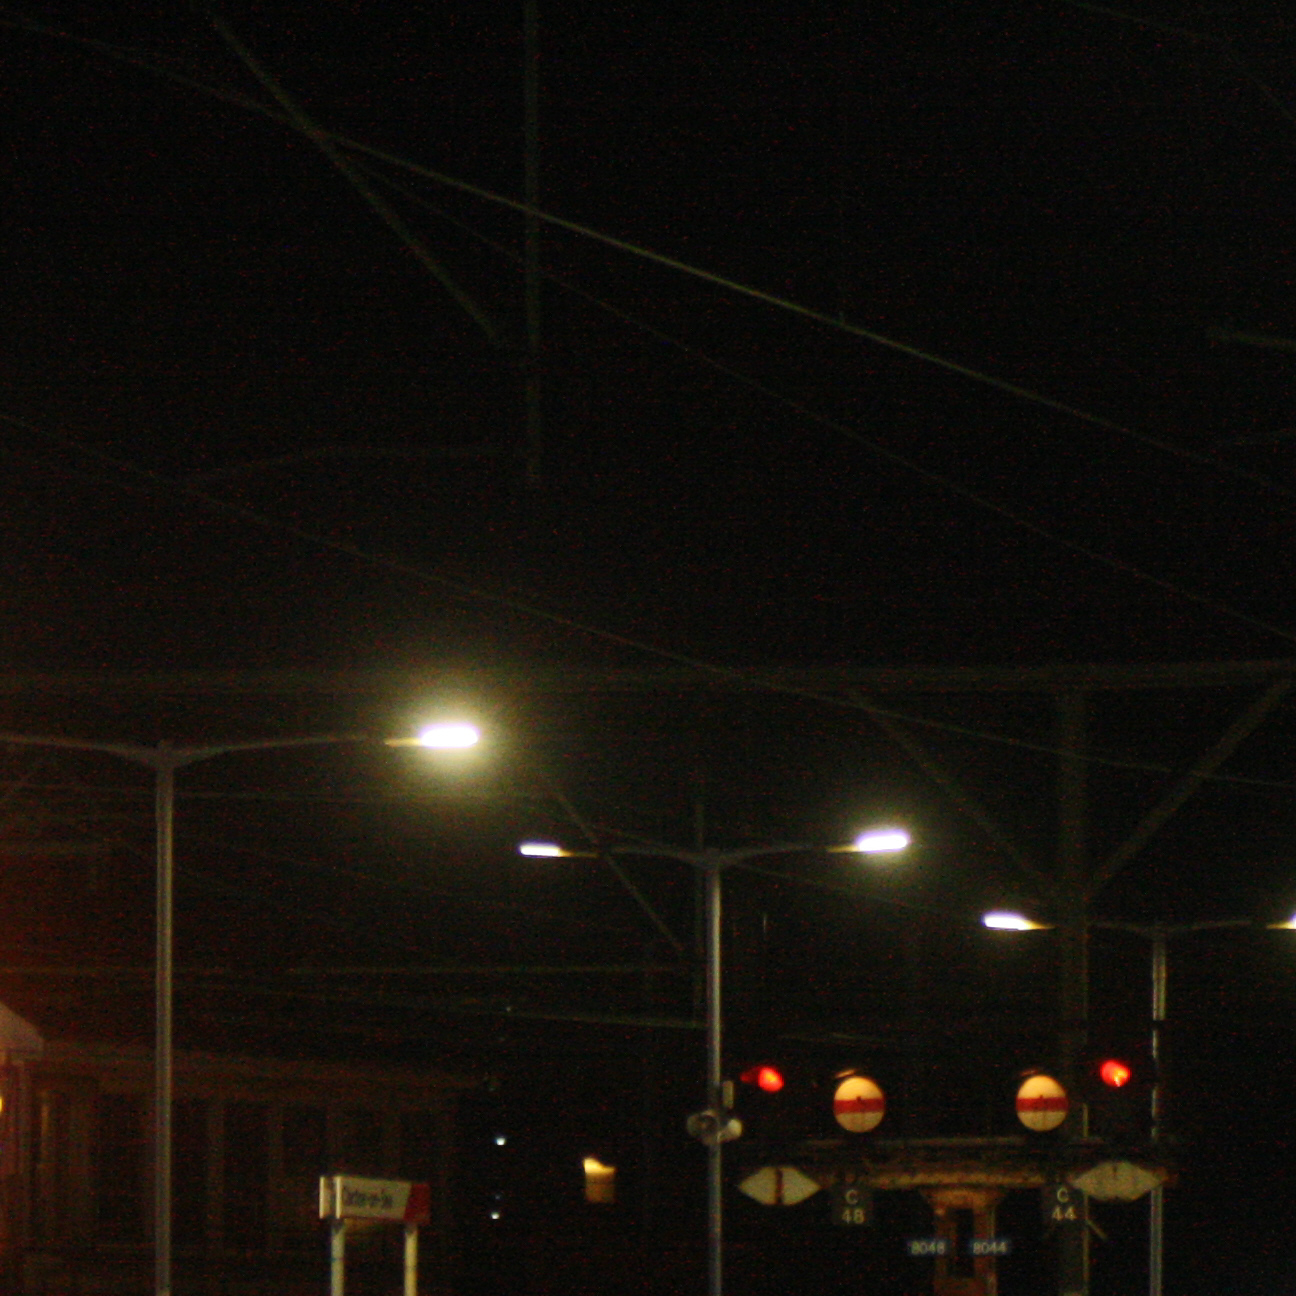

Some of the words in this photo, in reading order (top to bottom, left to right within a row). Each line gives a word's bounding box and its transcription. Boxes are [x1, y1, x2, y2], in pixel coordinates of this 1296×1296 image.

[845, 1189, 858, 1205] C
[1057, 1187, 1069, 1203] C
[841, 1208, 865, 1224] 48
[1051, 1205, 1077, 1221] 44
